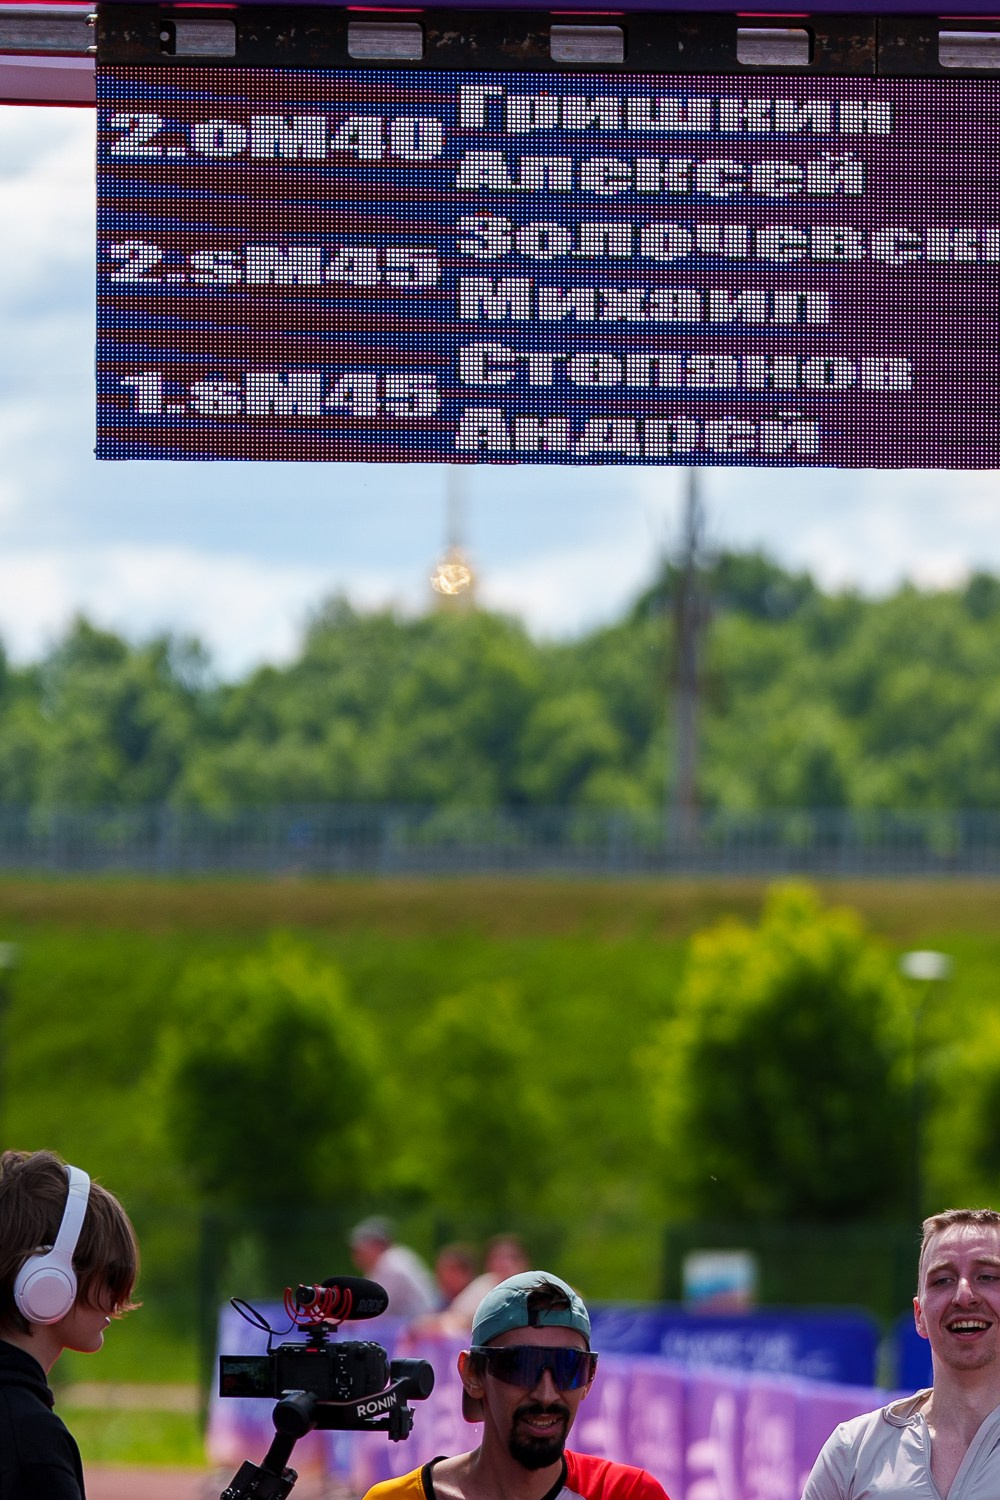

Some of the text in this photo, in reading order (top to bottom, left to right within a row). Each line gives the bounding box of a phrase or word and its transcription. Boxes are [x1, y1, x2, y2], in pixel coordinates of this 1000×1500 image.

[459, 85, 892, 134] Гришкин
[455, 149, 864, 197] Алексей
[459, 276, 830, 324] Михаил
[458, 342, 913, 391] Степанов
[455, 406, 820, 458] Андрей
[356, 1392, 397, 1417] RONIN
